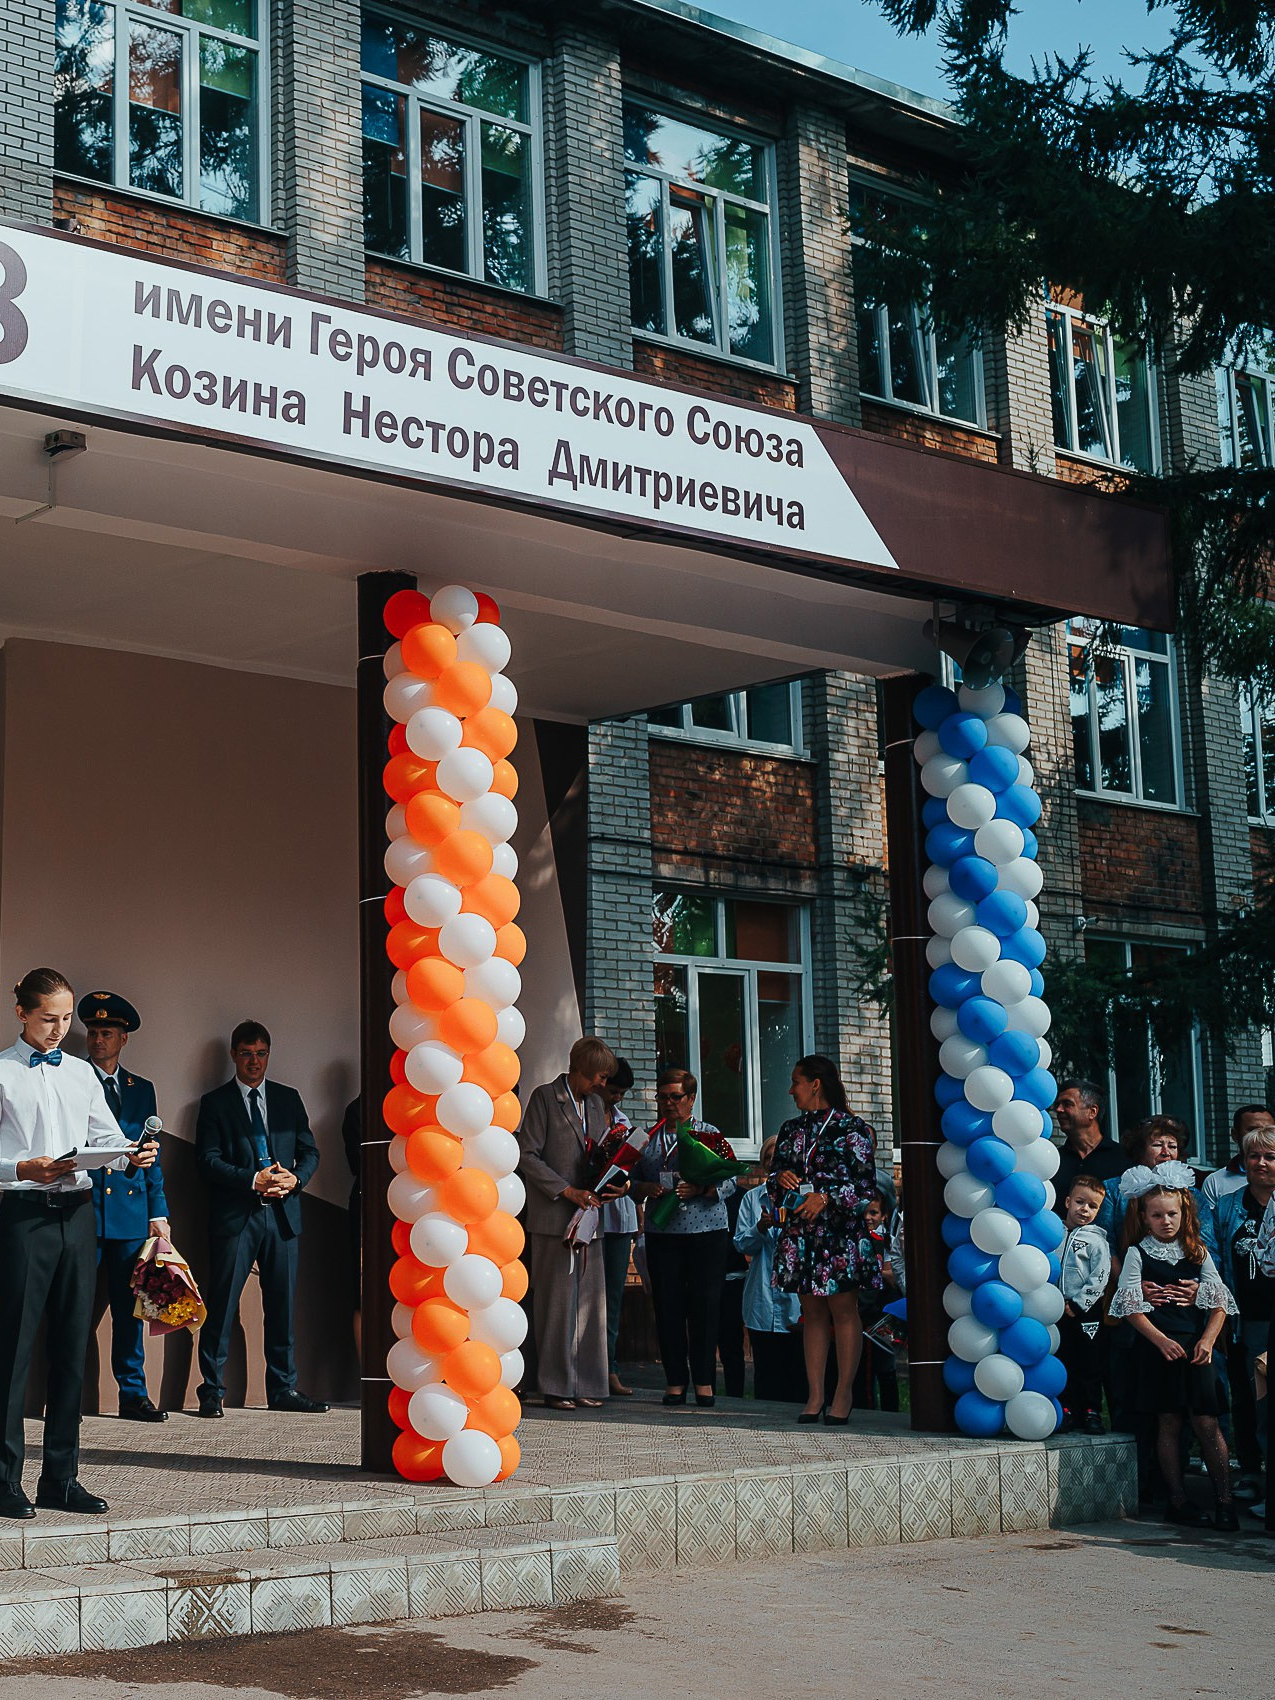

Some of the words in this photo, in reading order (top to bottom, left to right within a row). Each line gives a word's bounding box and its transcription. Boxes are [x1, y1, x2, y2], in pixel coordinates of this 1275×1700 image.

[131, 344, 306, 426] Козина
[342, 391, 520, 473] Нестора
[547, 438, 805, 531] Дмитриевича
[134, 280, 292, 350] имени
[309, 312, 432, 377] Героя
[447, 346, 675, 437] Советского
[686, 406, 805, 468] Союза
